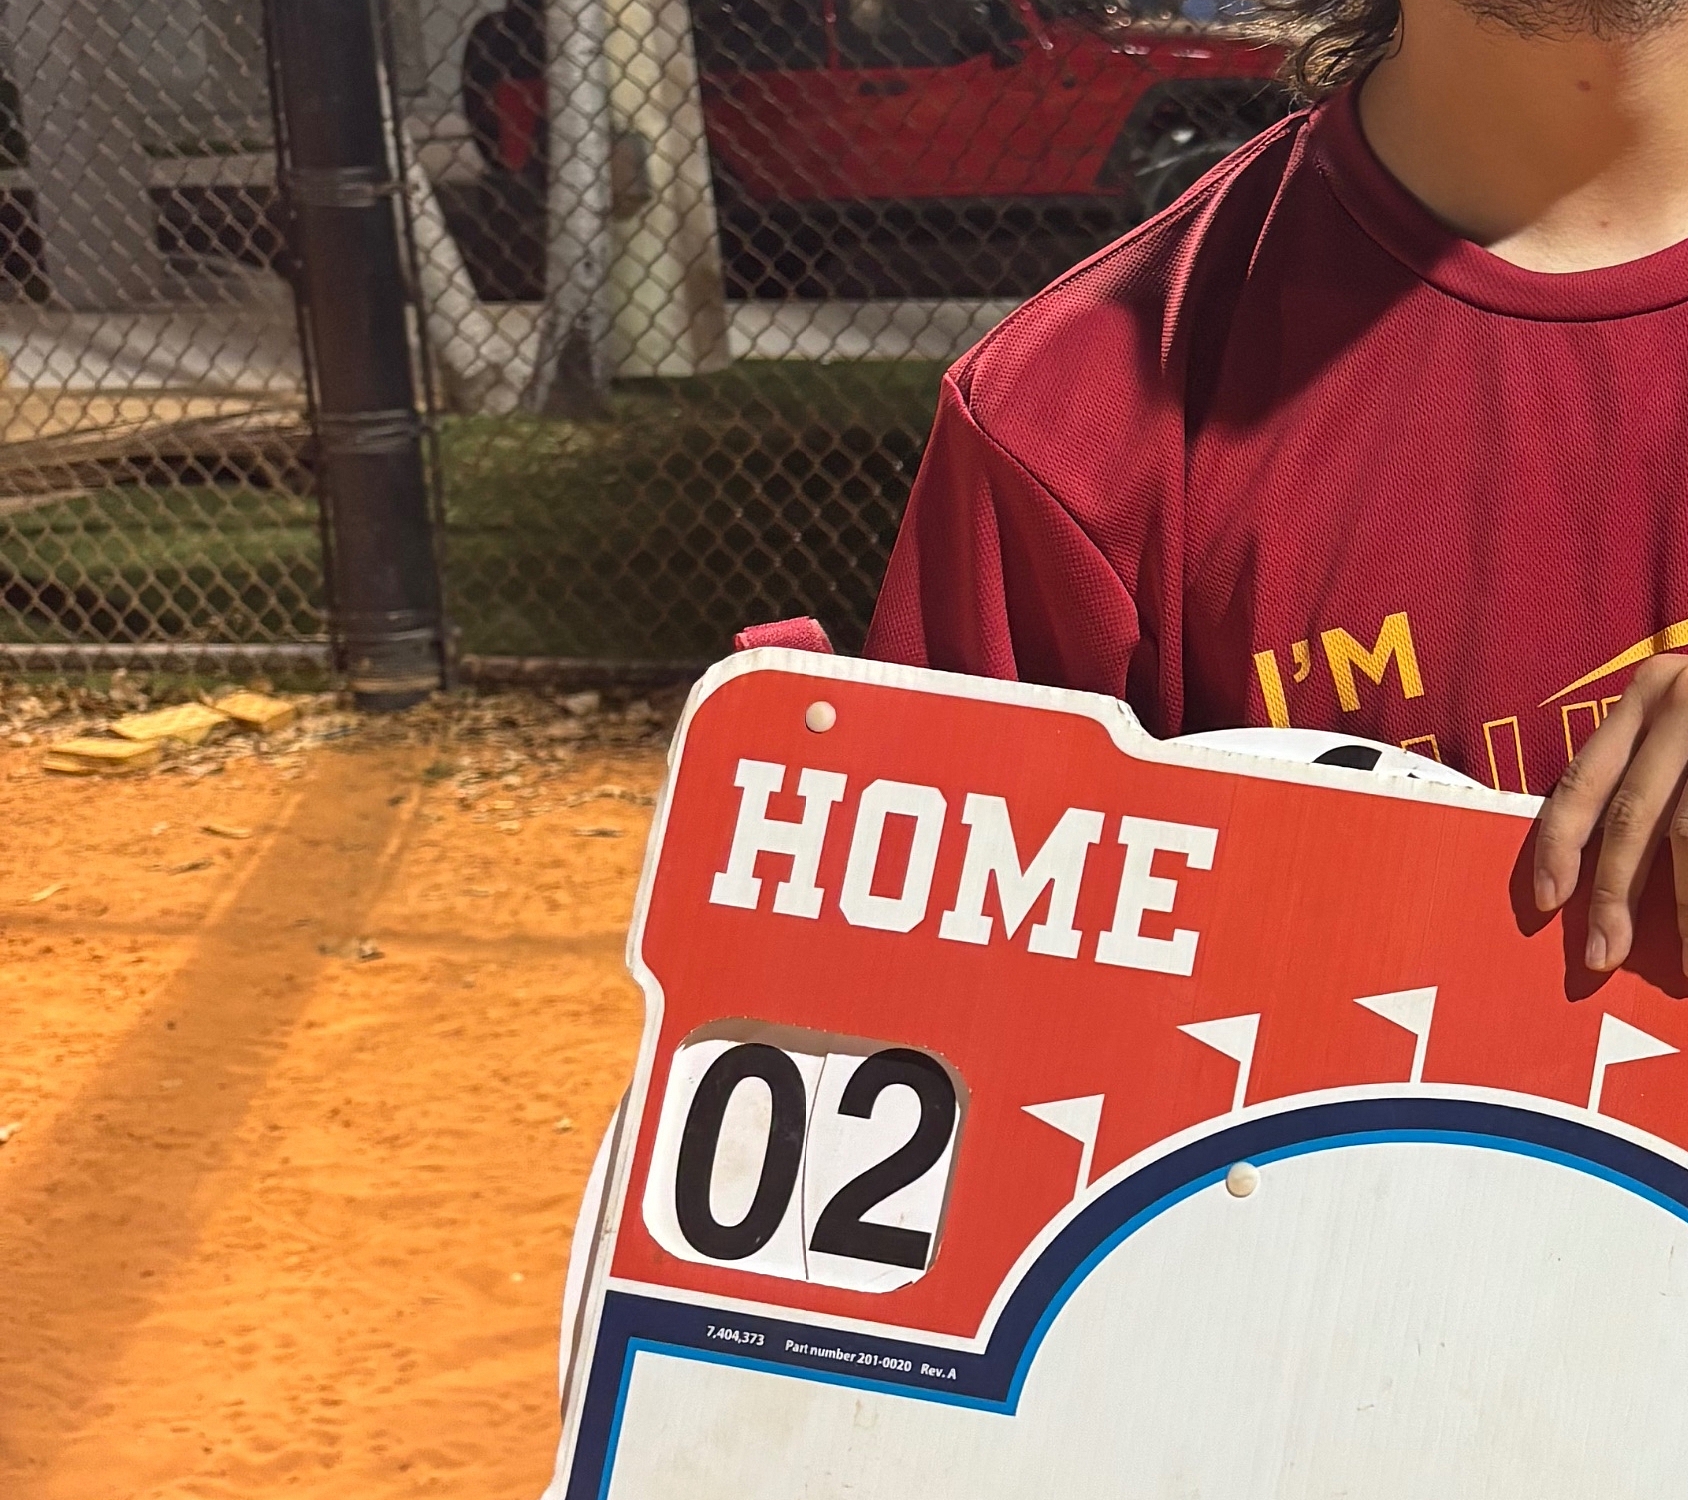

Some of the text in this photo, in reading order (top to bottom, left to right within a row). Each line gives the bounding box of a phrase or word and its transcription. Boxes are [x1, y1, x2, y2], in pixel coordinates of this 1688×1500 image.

[1254, 612, 1423, 728] I'M
[708, 758, 1219, 977] HOME
[675, 1042, 957, 1271] 02
[706, 1325, 957, 1380] 7,404,373 Part number 201-0020 Rev. A
